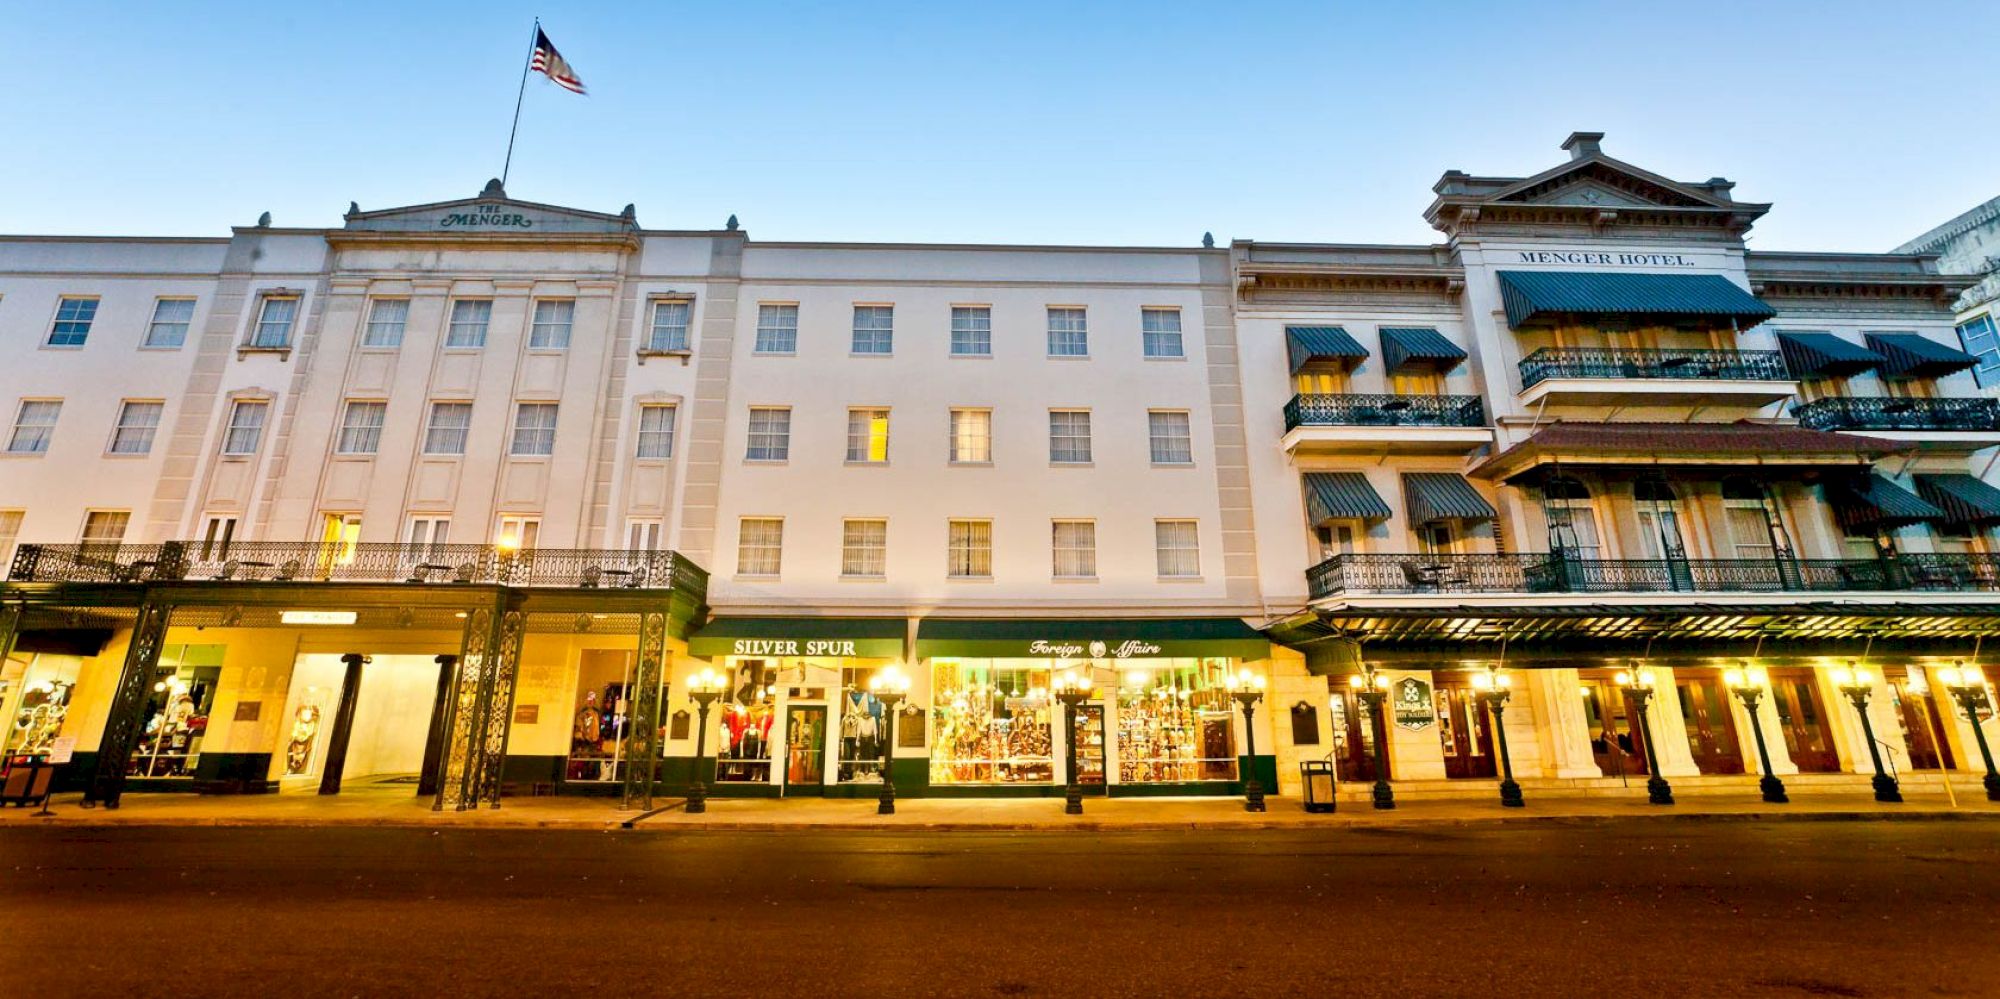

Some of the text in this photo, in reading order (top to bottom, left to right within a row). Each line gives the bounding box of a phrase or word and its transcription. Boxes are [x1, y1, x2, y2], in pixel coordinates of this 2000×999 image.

[479, 205, 501, 213] THE
[441, 214, 532, 227] MENGER
[1519, 252, 1613, 264] MENGER
[734, 640, 856, 655] SILVER SPUR
[1029, 640, 1161, 657] Foreign Affairs
